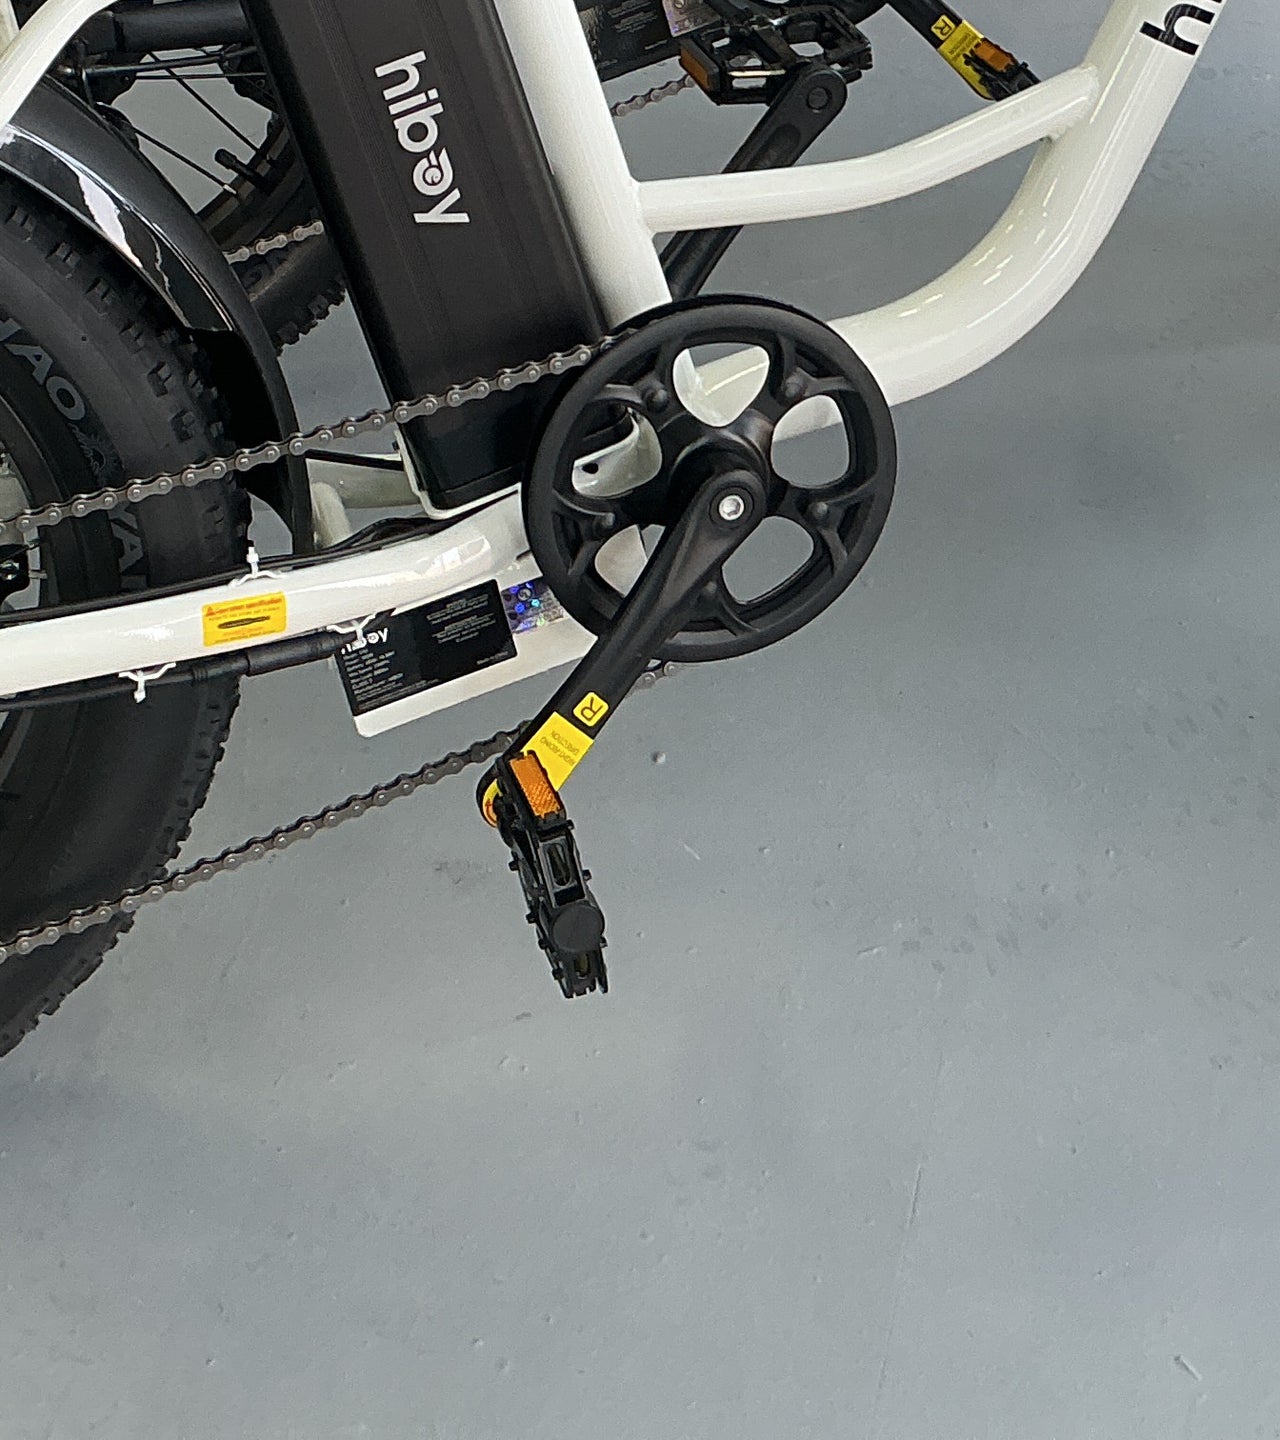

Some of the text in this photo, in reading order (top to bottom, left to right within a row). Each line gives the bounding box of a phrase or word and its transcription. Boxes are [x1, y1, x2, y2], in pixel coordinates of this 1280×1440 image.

[933, 18, 952, 36] R
[374, 50, 470, 225] hiboy
[581, 696, 604, 722] R
